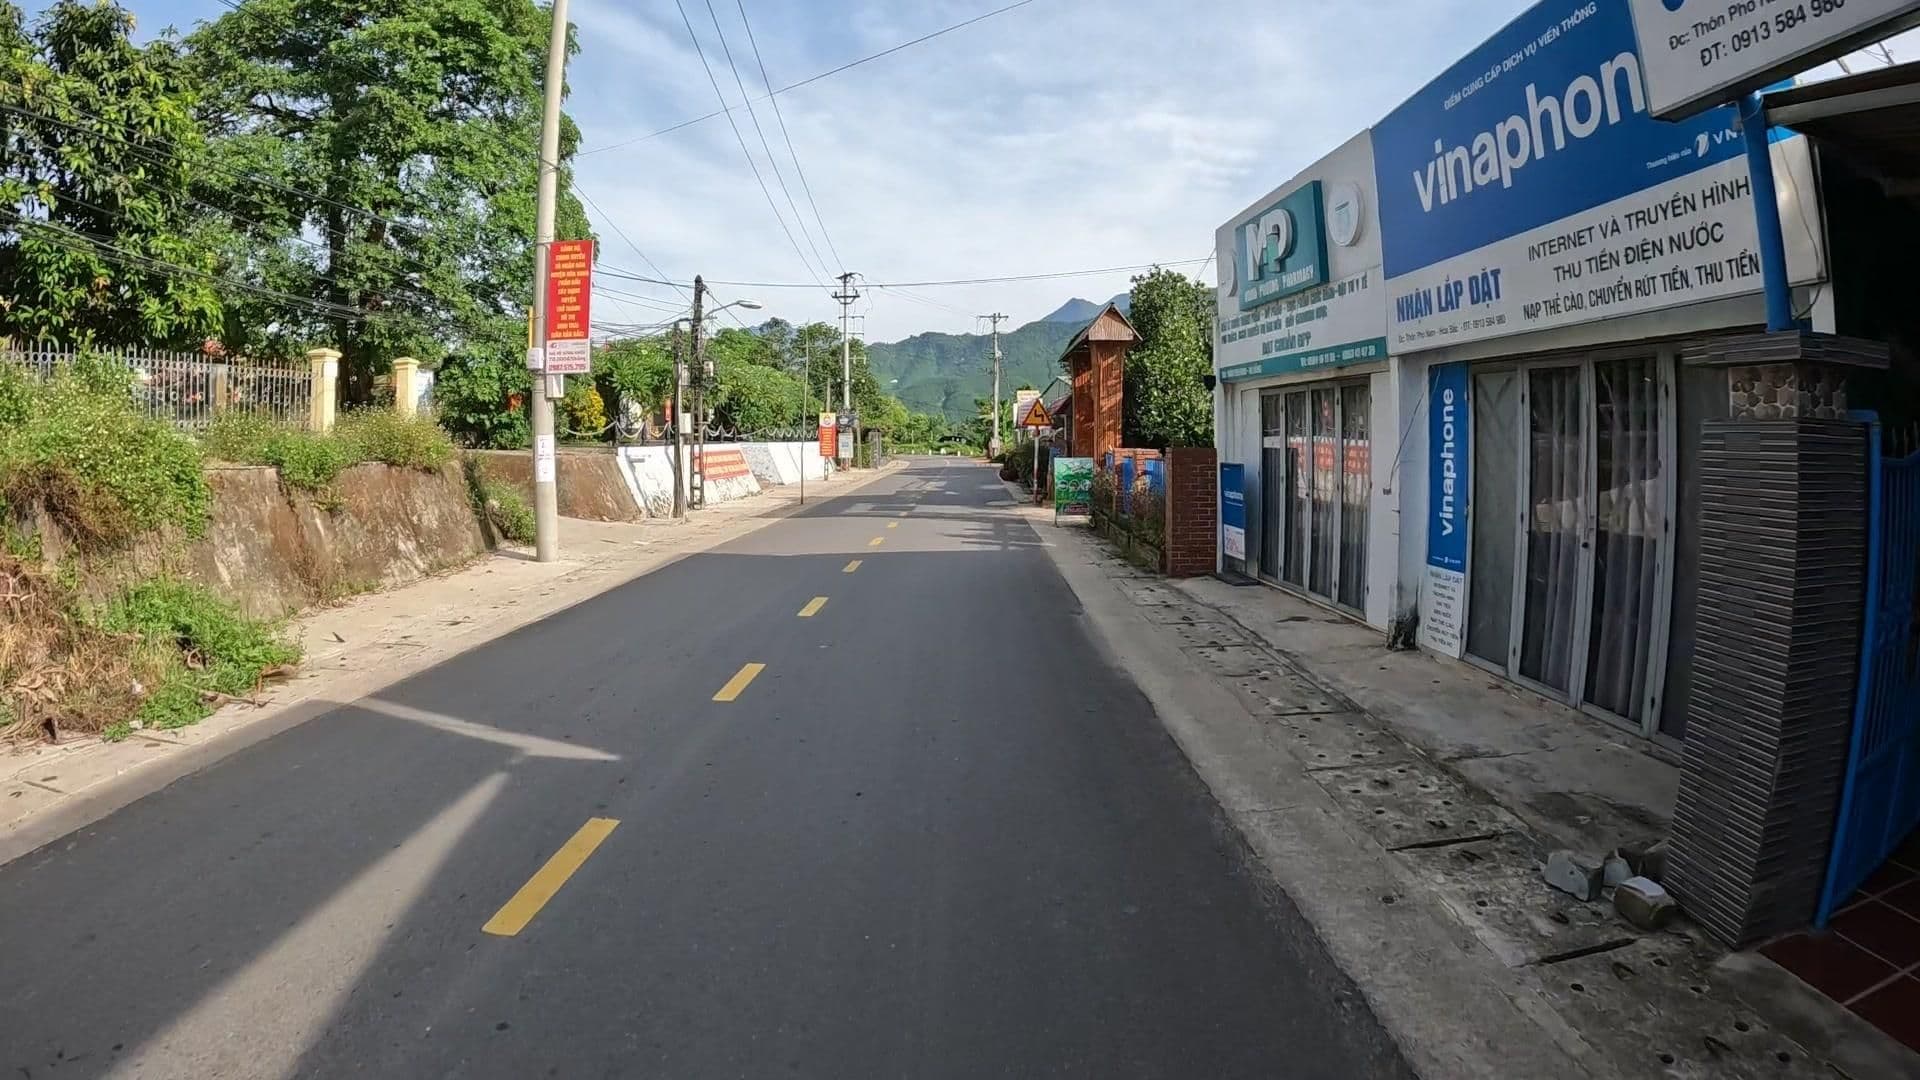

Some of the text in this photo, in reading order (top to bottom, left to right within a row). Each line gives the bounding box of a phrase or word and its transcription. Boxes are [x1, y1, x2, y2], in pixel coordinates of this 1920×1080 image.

[1462, 77, 1485, 99] CUNG
[1561, 1, 1597, 33] THÔNG
[1700, 42, 1728, 66] ĐT:
[1731, 21, 1770, 52] 0913
[1775, 4, 1806, 33] 584
[1413, 52, 1646, 213] vinaphon
[1528, 175, 1751, 262] INTERNET VÀ TRUYỀN HÌNH
[1554, 262, 1582, 283] THU
[1624, 236, 1664, 265] ĐIỆN
[1669, 221, 1725, 255] NƯỚC
[1396, 266, 1501, 323] NHẬN LẮP ĐẶT
[1523, 301, 1542, 322] NẠP
[1543, 291, 1562, 314] THẺ
[1589, 275, 1632, 308] CHUYỂN
[1635, 274, 1657, 298] RÚT
[1695, 263, 1724, 286] THU
[1725, 248, 1760, 277] TIỀN
[1439, 388, 1456, 536] vinaphone
